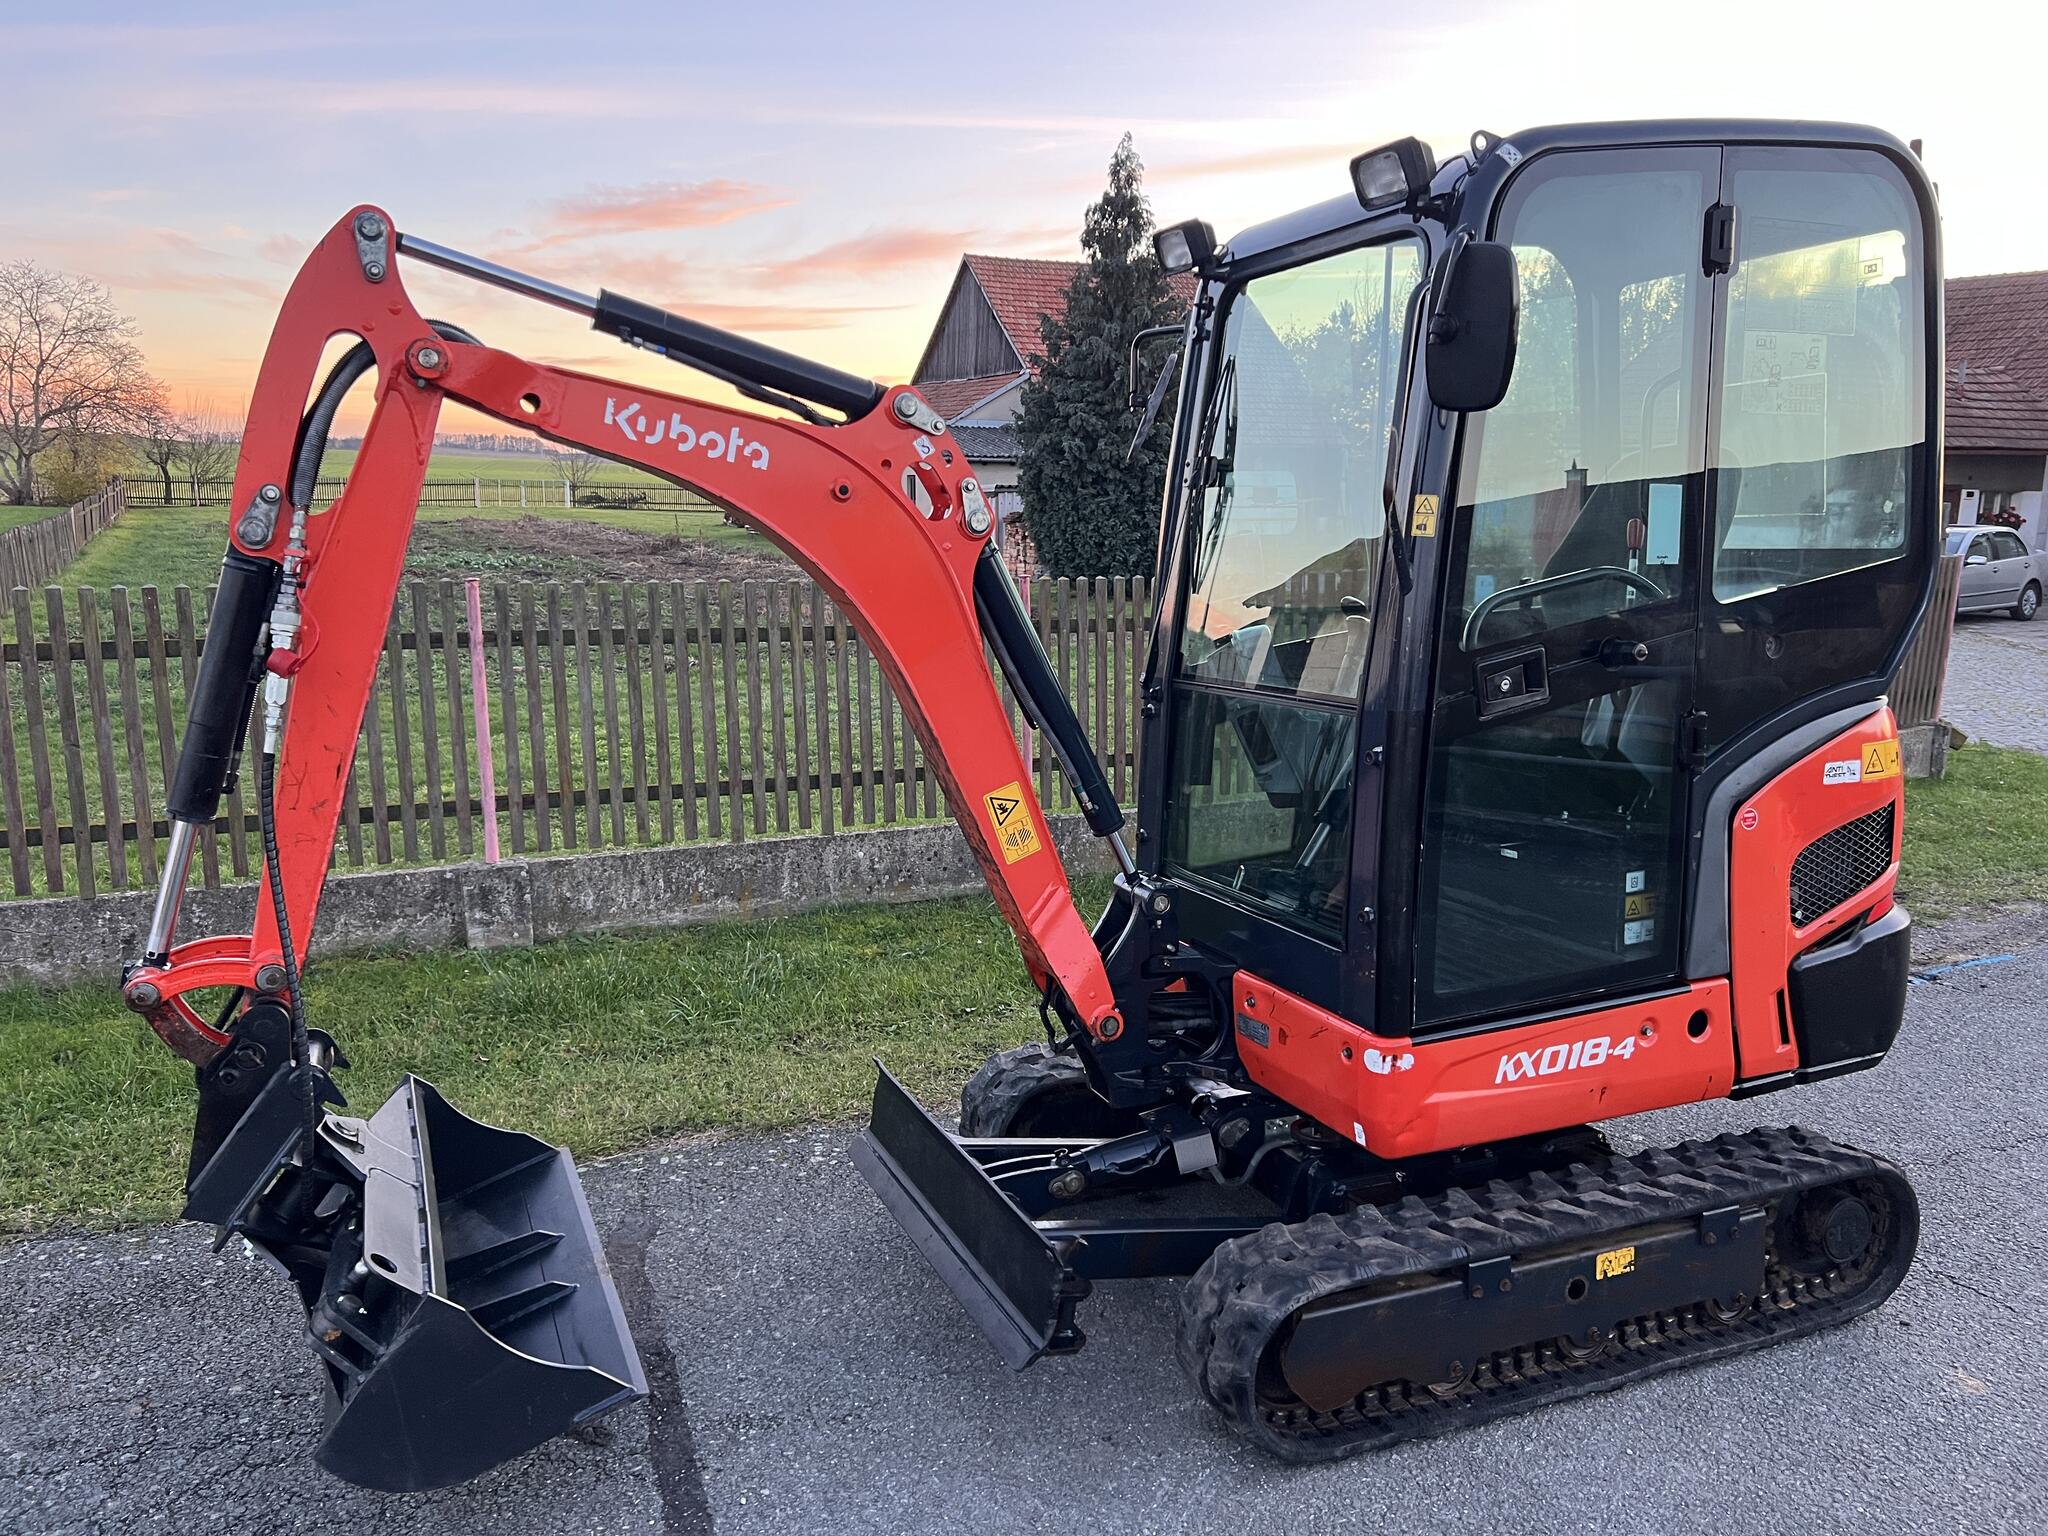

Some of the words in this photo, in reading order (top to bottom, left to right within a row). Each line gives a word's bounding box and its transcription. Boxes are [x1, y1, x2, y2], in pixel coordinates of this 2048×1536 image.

[604, 397, 769, 470] Kubota
[1825, 766, 1844, 774] ANTI
[1494, 1036, 1636, 1085] KX018-4
